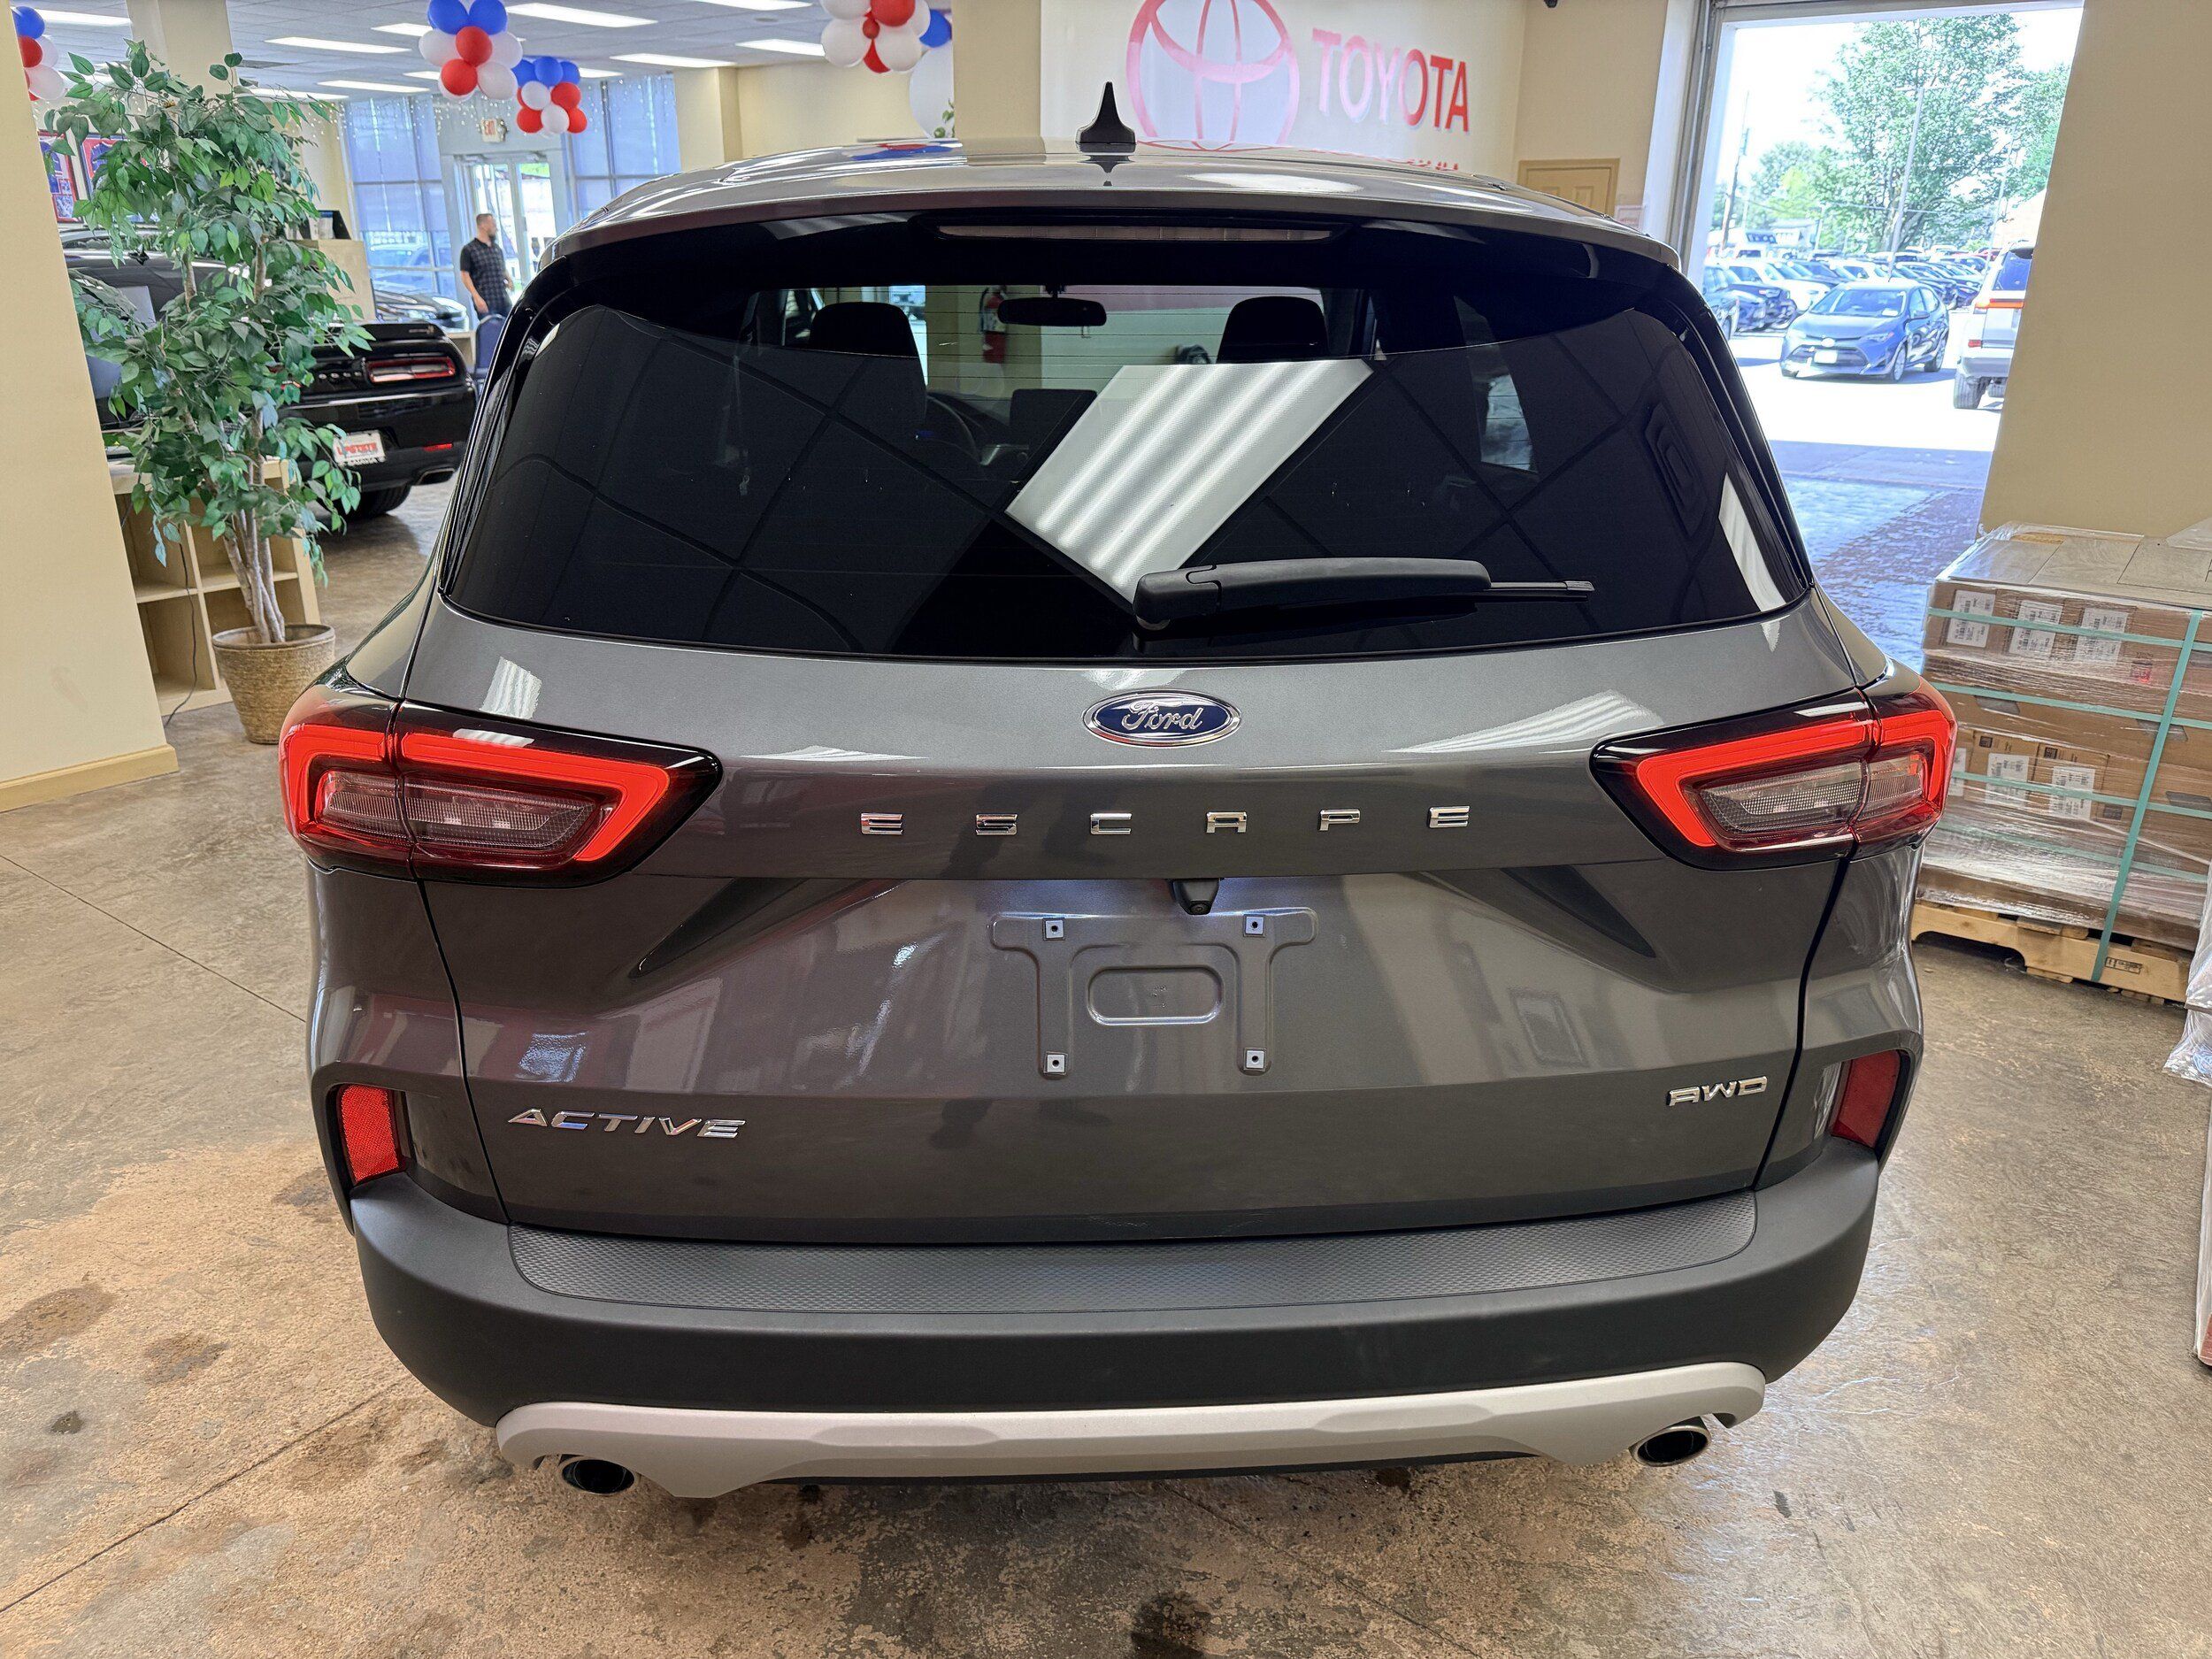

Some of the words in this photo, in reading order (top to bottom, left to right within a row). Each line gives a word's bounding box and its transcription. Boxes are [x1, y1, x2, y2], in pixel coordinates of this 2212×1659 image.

[1312, 27, 1470, 133] TOYOTA
[1121, 700, 1204, 731] Ford
[860, 804, 1471, 836] ESCAPE
[1668, 1075, 1768, 1107] AWD
[507, 1108, 746, 1139] ACTIVE
